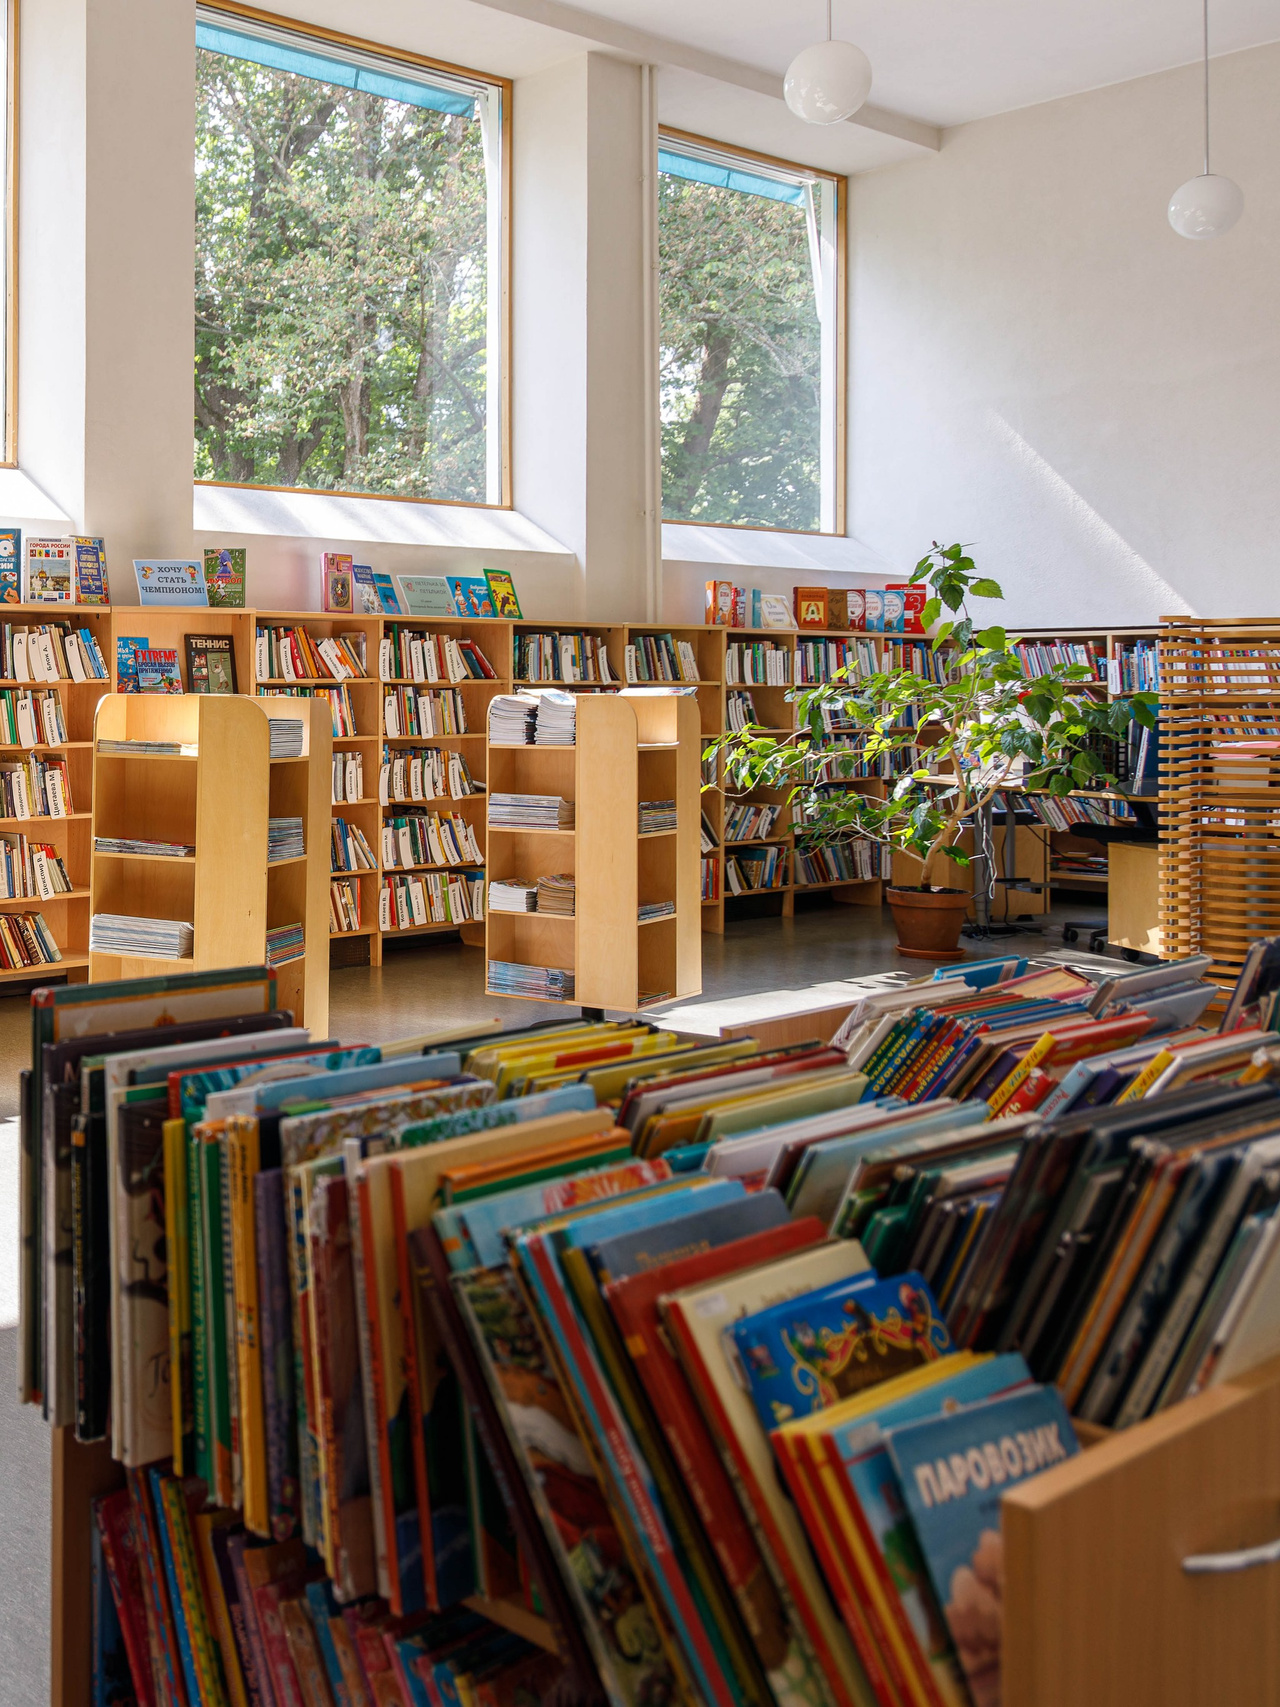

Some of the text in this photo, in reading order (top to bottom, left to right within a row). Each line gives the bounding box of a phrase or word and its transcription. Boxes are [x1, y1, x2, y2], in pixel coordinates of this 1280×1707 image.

[157, 576, 187, 584] СТАТЬ
[207, 576, 242, 585] ФУТБОЛ
[141, 586, 205, 595] ЧЕМПИОНОМ!
[190, 639, 229, 649] ТЕННИС
[135, 650, 177, 662] EXTREME
[49, 771, 60, 816] Цветаева М.
[39, 864, 49, 895] Шекспир
[870, 1037, 918, 1092] ЧУДО-ЮДО
[914, 1421, 1067, 1507] ПАРОВОЗИК
